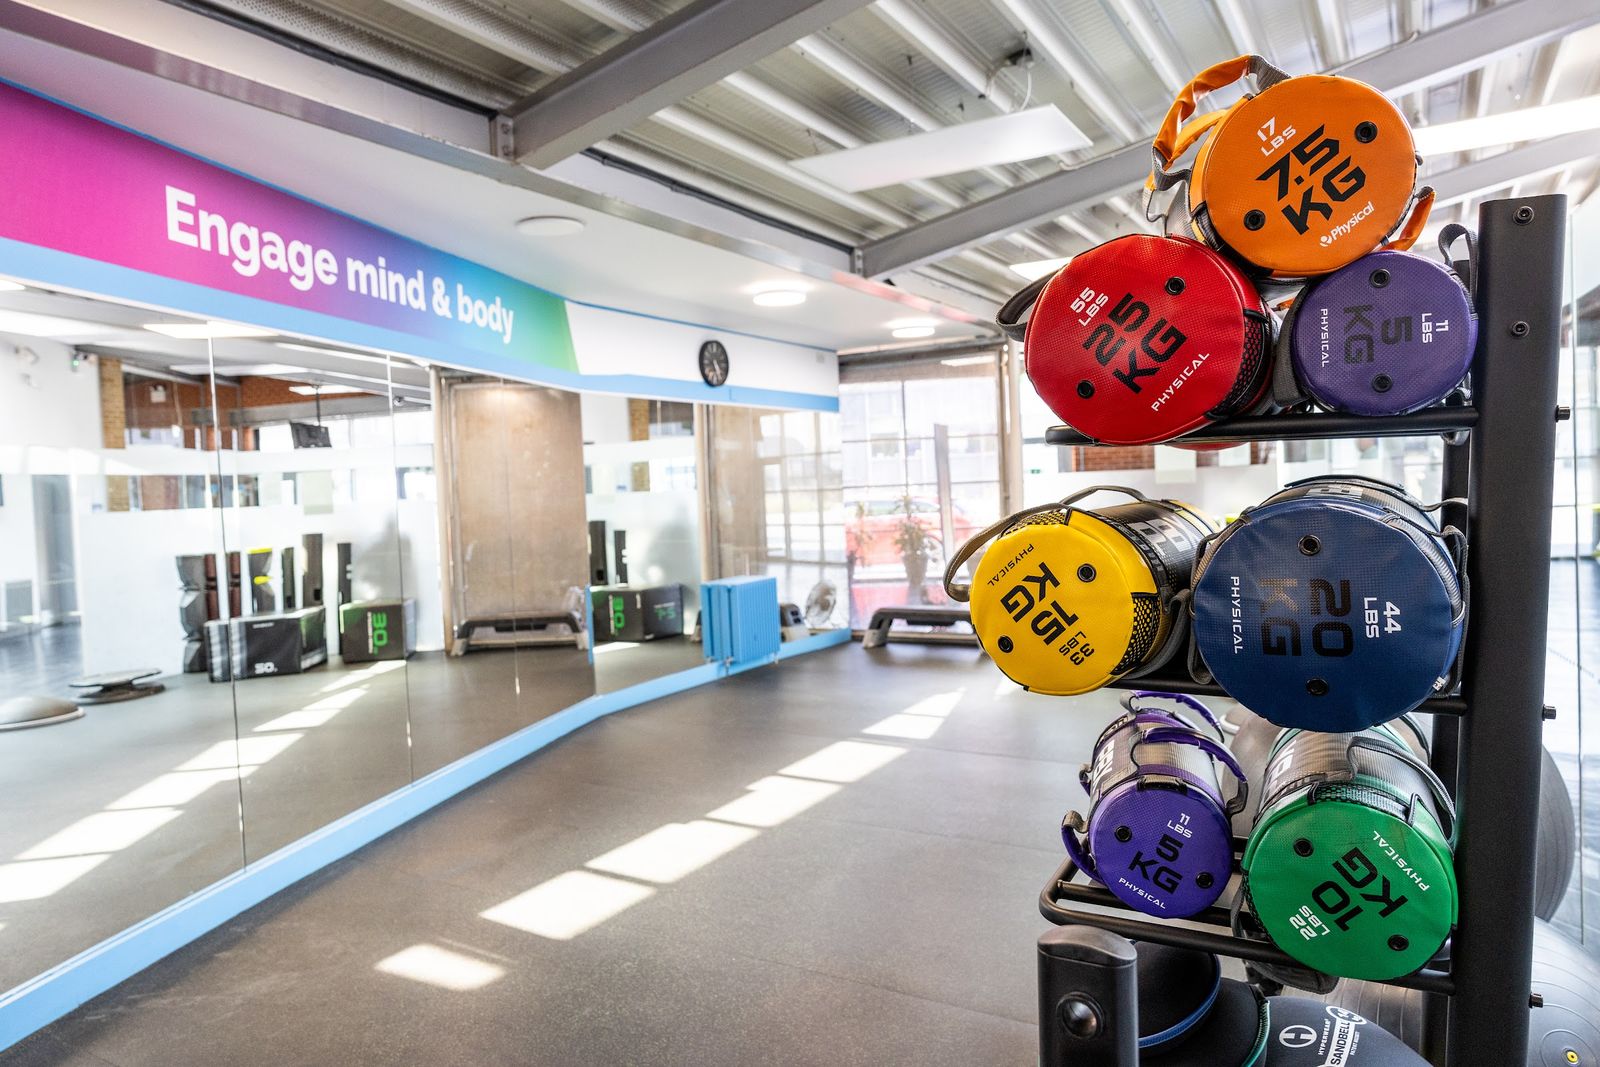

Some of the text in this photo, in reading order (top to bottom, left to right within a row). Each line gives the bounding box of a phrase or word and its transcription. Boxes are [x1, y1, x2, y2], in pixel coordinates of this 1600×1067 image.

[1257, 116, 1275, 142] 17
[1260, 124, 1297, 156] LBS
[1255, 124, 1340, 201] 7.5
[1281, 155, 1367, 235] KG
[1330, 201, 1375, 240] Physical
[165, 184, 514, 344] Engage mind & body
[1070, 286, 1096, 313] 55
[1078, 293, 1109, 327] LBS
[1082, 292, 1151, 367] 25
[1320, 308, 1330, 368] PHYSICAL
[1342, 304, 1374, 365] KG
[1380, 315, 1412, 345] 5
[1421, 312, 1433, 344] LBS
[1436, 319, 1448, 332] 11
[1112, 318, 1188, 395] KG
[1151, 352, 1210, 412] PHYSICAL
[987, 543, 1034, 587] PHYSICAL
[1000, 561, 1061, 623] KG
[1030, 600, 1080, 646] 15
[1230, 576, 1244, 655] PHYSICAL
[1258, 578, 1300, 657] KG
[1309, 578, 1354, 657] 20
[1363, 597, 1380, 639] LBS
[1383, 601, 1402, 634] 44
[1058, 631, 1086, 656] LBS
[1069, 643, 1095, 666] 33
[1167, 820, 1193, 839] LBS
[1179, 813, 1191, 826] 11
[1155, 833, 1184, 863] 5
[1372, 830, 1430, 892] PHYSICAL
[1118, 877, 1167, 909] PHYSICAL
[1127, 850, 1184, 895] KG
[1332, 846, 1409, 919] KG
[1298, 905, 1331, 937] LBS
[1311, 880, 1364, 932] 10
[1288, 916, 1318, 941] 22
[1330, 1022, 1350, 1066] SANDBELL
